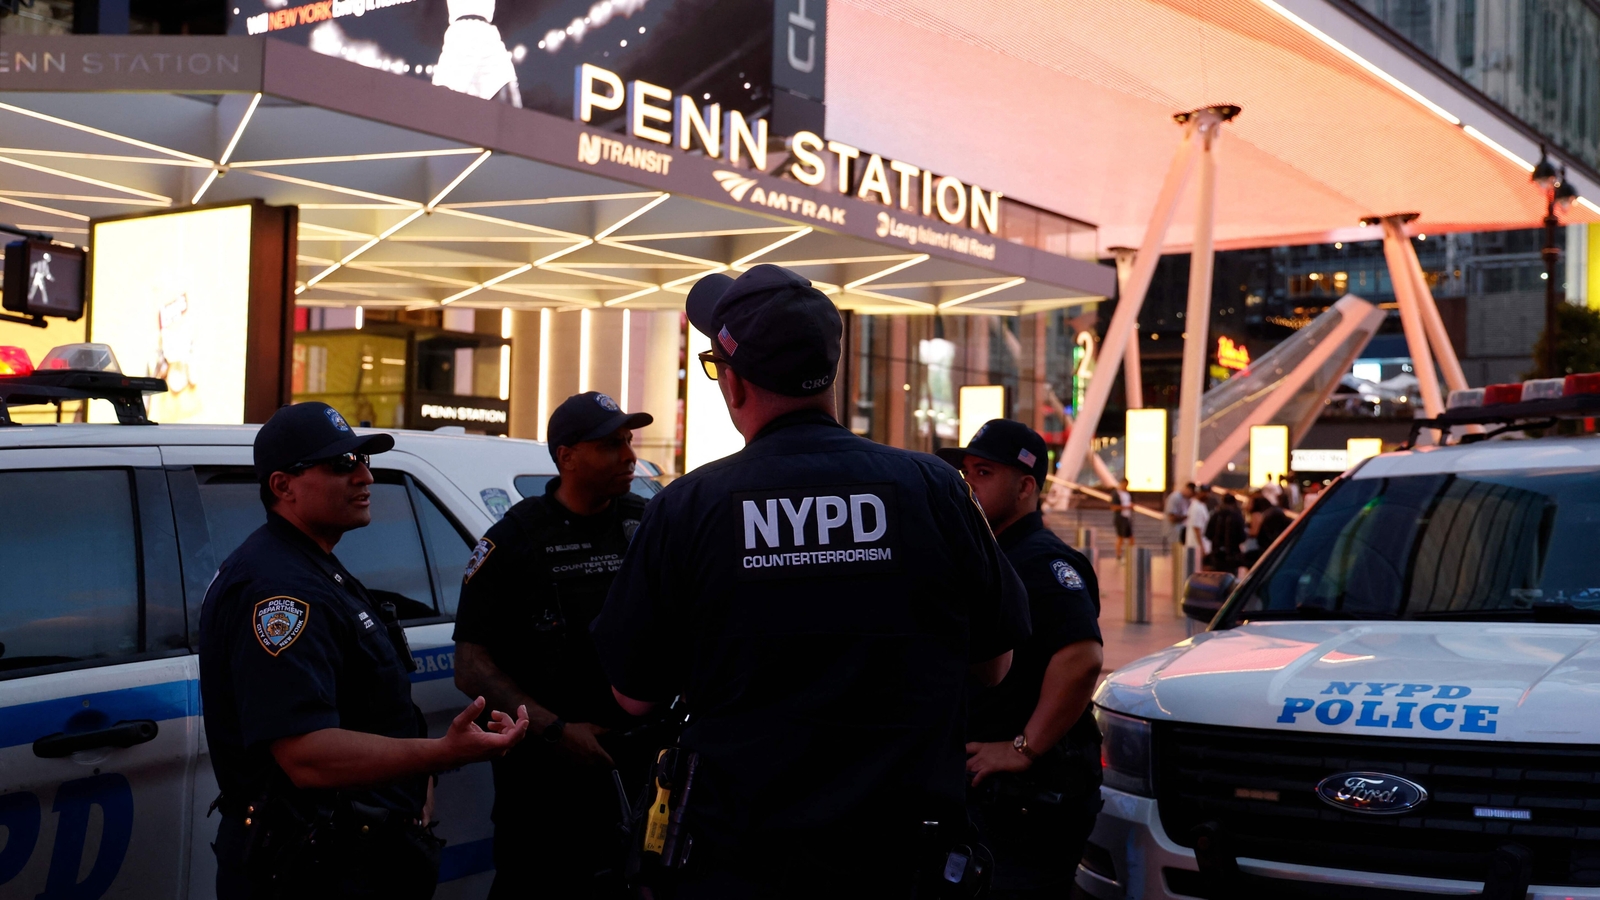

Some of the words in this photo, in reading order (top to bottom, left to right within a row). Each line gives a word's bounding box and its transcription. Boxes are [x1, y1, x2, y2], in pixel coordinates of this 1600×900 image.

[269, 8, 298, 31] NEW
[297, 0, 333, 25] YORK
[82, 52, 240, 74] STATION
[575, 62, 769, 171] PENN
[791, 131, 1000, 234] STATION
[601, 138, 673, 176] TRANSIT
[750, 187, 846, 226] AMTRAK
[890, 217, 918, 246] Long
[918, 225, 949, 250] Island
[949, 233, 969, 255] Rail
[969, 238, 996, 260] Road
[801, 375, 829, 390] CRC
[421, 404, 457, 420] PENN
[457, 407, 507, 423] STATION
[742, 493, 887, 550] NYPD
[590, 553, 619, 563] NYPD
[743, 547, 892, 569] COUNTERTERRORISM
[258, 604, 304, 617] DEPARTMENT
[268, 599, 295, 608] POLICE
[256, 623, 266, 639] CITY
[262, 637, 271, 647] OF
[279, 635, 292, 648] NEW
[290, 619, 304, 637] YORK
[1320, 681, 1472, 699] NYPD
[1276, 697, 1500, 734] POLICE
[1336, 777, 1398, 803] Ford
